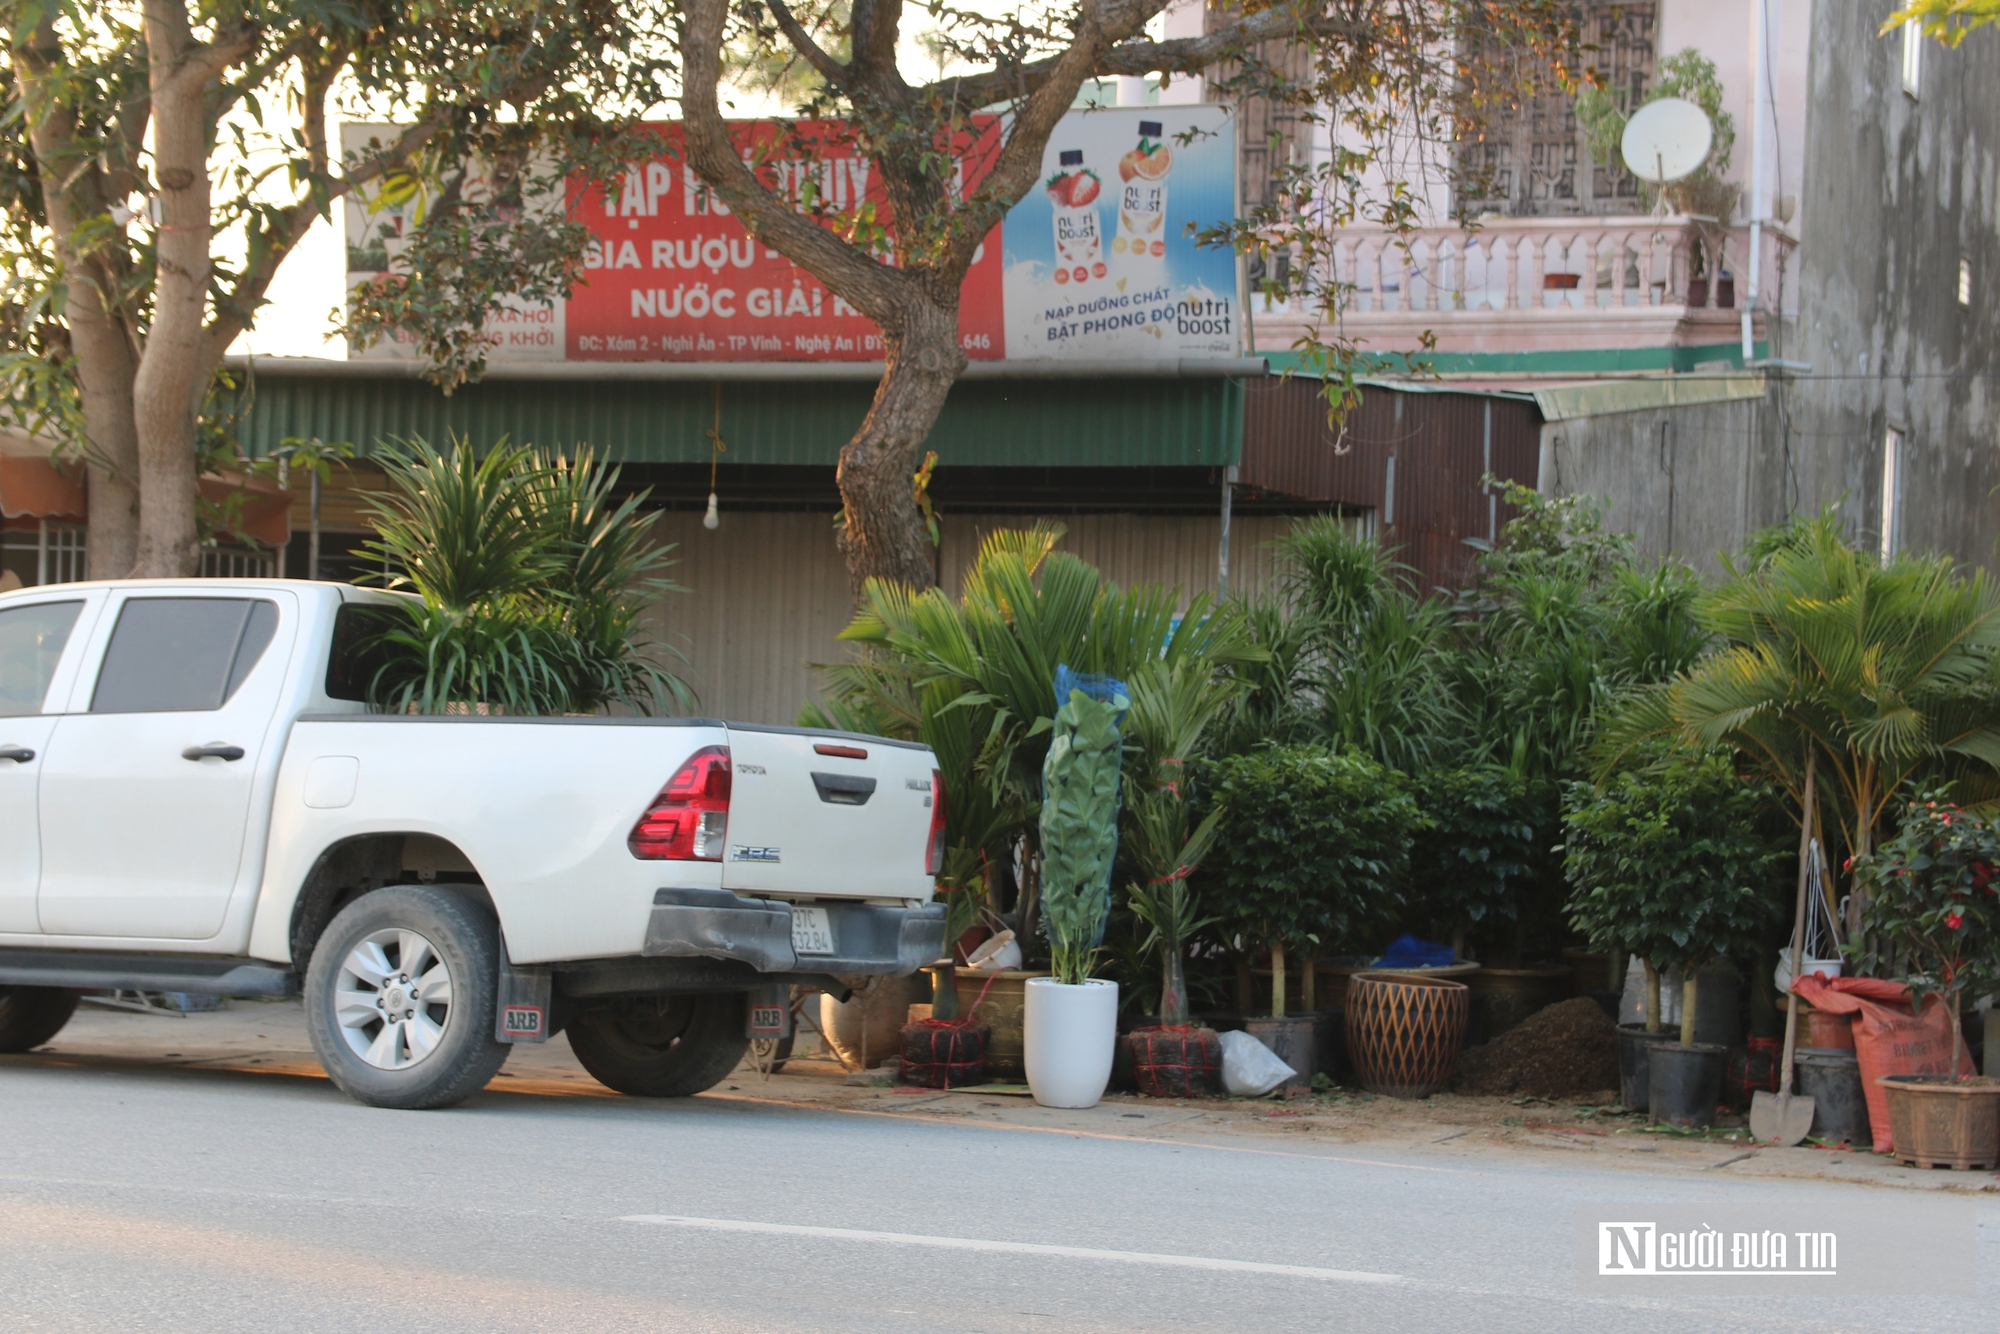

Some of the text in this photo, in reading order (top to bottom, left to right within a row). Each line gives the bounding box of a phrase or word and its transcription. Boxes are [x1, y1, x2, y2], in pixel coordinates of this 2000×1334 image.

[582, 239, 642, 270] BIA
[652, 233, 755, 275] RƯỢU
[631, 282, 736, 318] NƯỚC
[746, 279, 822, 318] GIẢI
[1045, 286, 1170, 322] NẠP DƯỠNG CHẤT
[1177, 297, 1229, 317] nutri
[1047, 303, 1175, 342] BẬT PHONG ĐỘ
[1177, 316, 1230, 335] boost
[606, 335, 637, 351] Xóm
[640, 335, 649, 351] 2
[662, 335, 694, 355] Nghi
[728, 335, 747, 351] TP
[751, 335, 781, 351] Vinh
[795, 335, 831, 354] Nghệ
[835, 335, 853, 351] An
[793, 908, 817, 929] 37C
[506, 1010, 539, 1031] ARB
[754, 1009, 781, 1027] ARB
